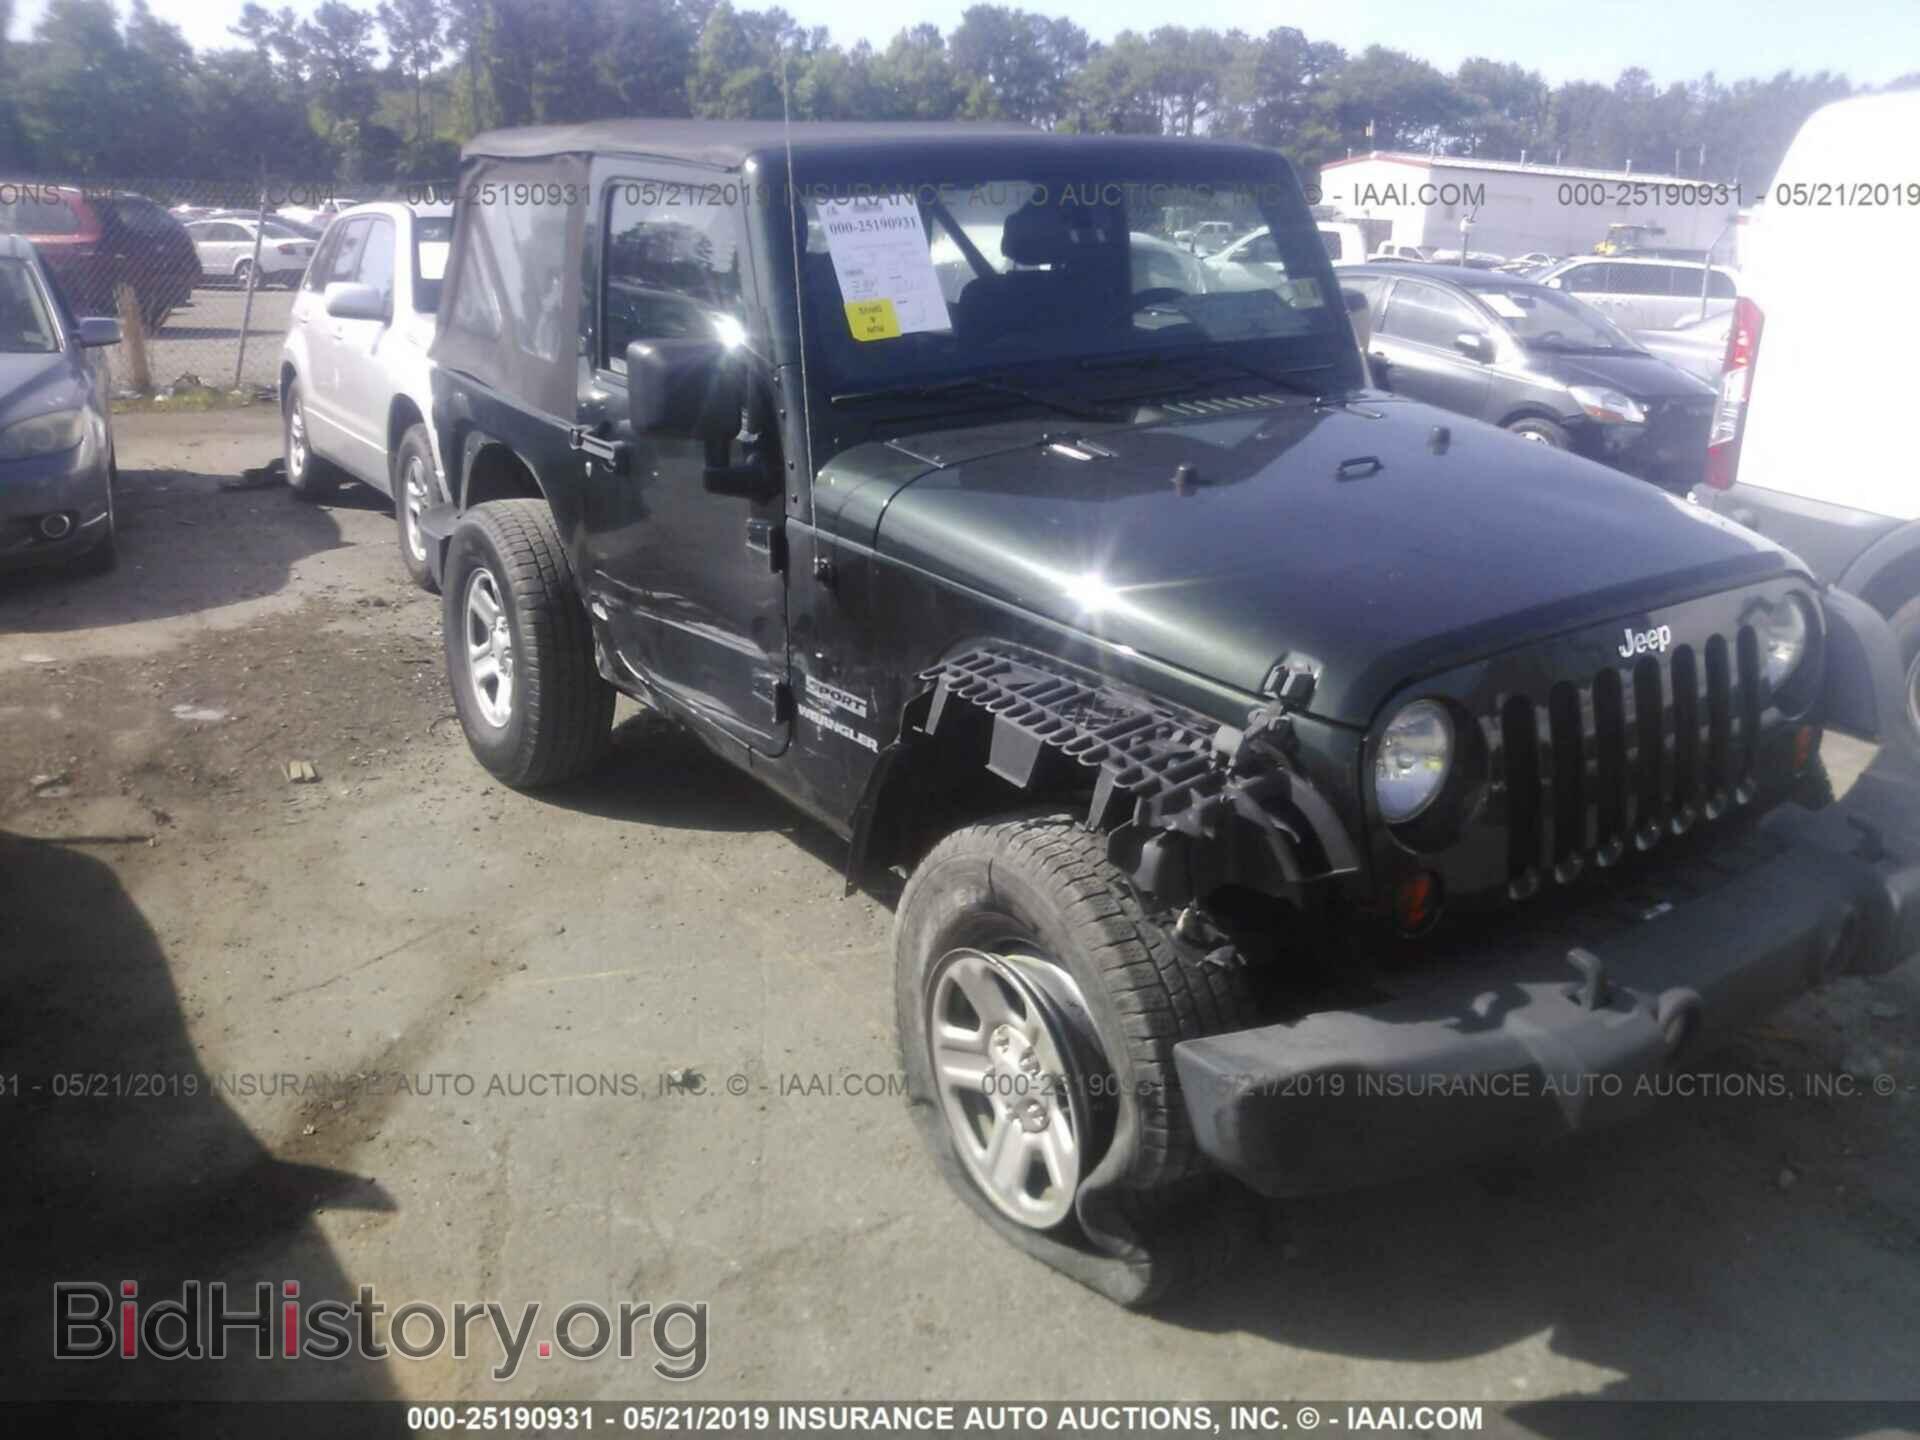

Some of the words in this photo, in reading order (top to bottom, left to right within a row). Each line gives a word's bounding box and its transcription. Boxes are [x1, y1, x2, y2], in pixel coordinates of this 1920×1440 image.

[1618, 624, 1671, 658] Jeep
[805, 674, 867, 718] SPORT
[797, 703, 879, 754] WRANGLER
